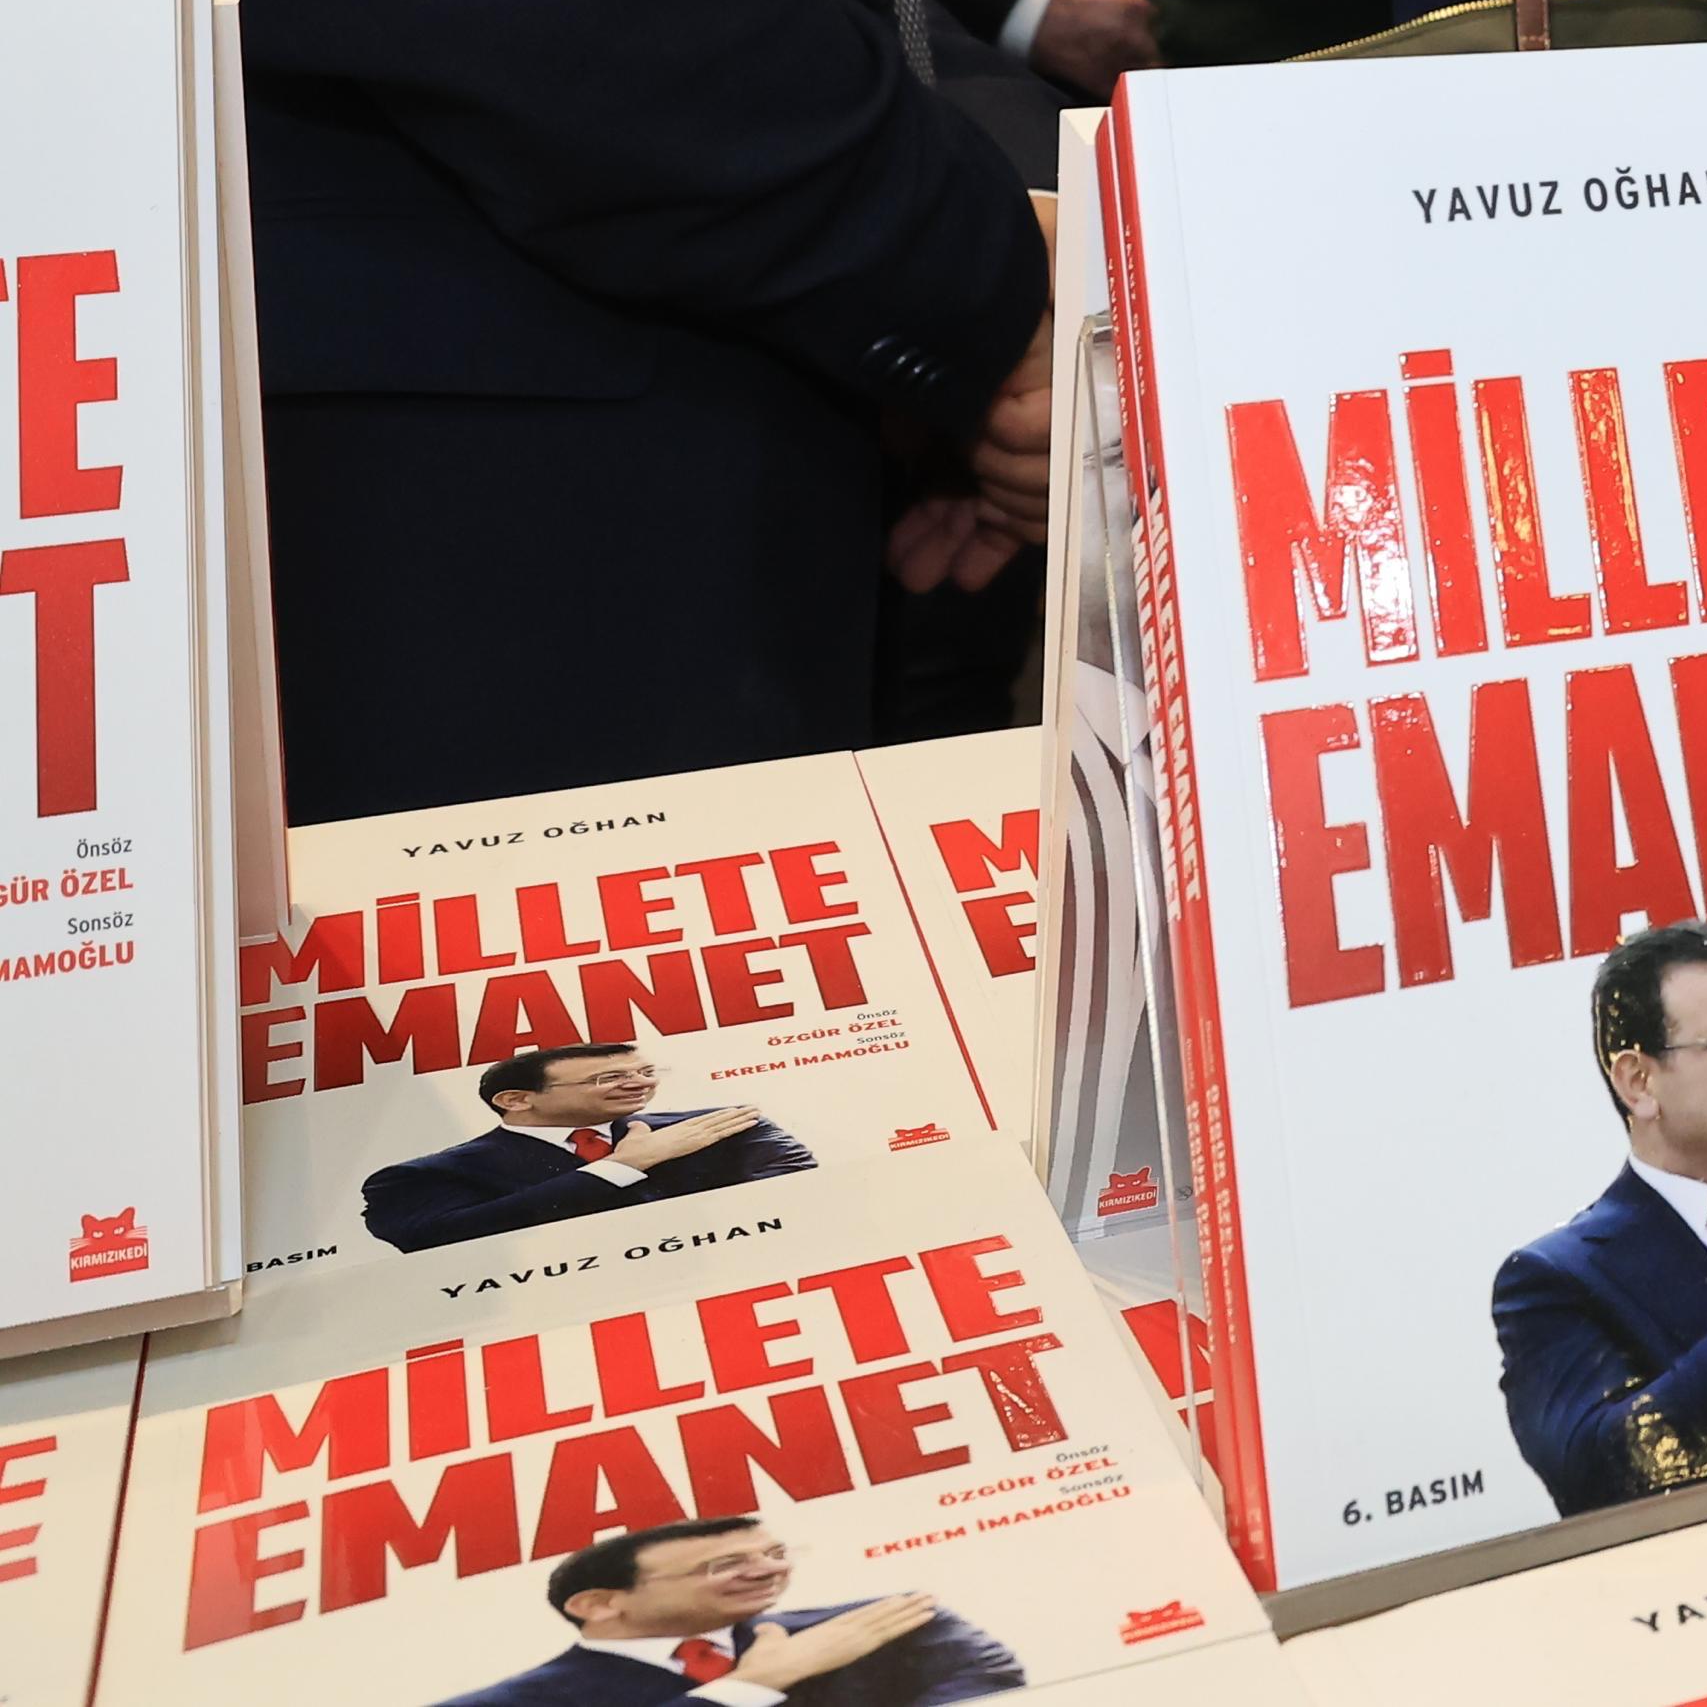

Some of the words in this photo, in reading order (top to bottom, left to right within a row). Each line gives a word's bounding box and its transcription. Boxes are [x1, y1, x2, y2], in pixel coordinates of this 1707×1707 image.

[1412, 180, 1564, 225] YAVUZ
[76, 837, 133, 859] Önsöz
[402, 831, 526, 859] YAVUZ
[543, 811, 668, 840] OĞHAN
[60, 867, 134, 898] ÖZEL
[67, 910, 134, 935] Sonsöz
[241, 840, 860, 1007] MİLLETE
[242, 922, 873, 1105] EMANET
[766, 1026, 841, 1048] ÖZGÜR
[847, 1017, 903, 1036] ÖZEL
[711, 1058, 787, 1081] EKREM
[794, 1039, 910, 1069] İMAMOĞLU
[69, 1242, 150, 1273] KIRMIZIKEDİ
[246, 1244, 339, 1274] BASIM
[440, 1255, 602, 1300] YAVUZ
[623, 1217, 785, 1261] OĞHAN
[196, 1234, 1044, 1515] MİLLETE
[183, 1333, 1066, 1651] EMANET
[938, 1469, 1034, 1508] ÖZGÜR
[1044, 1455, 1120, 1484] ÖZEL
[1342, 1499, 1374, 1527] 6.
[1384, 1468, 1487, 1517] BASIM
[863, 1522, 968, 1561] EKREM
[976, 1484, 1131, 1539] İMAMOĞLU
